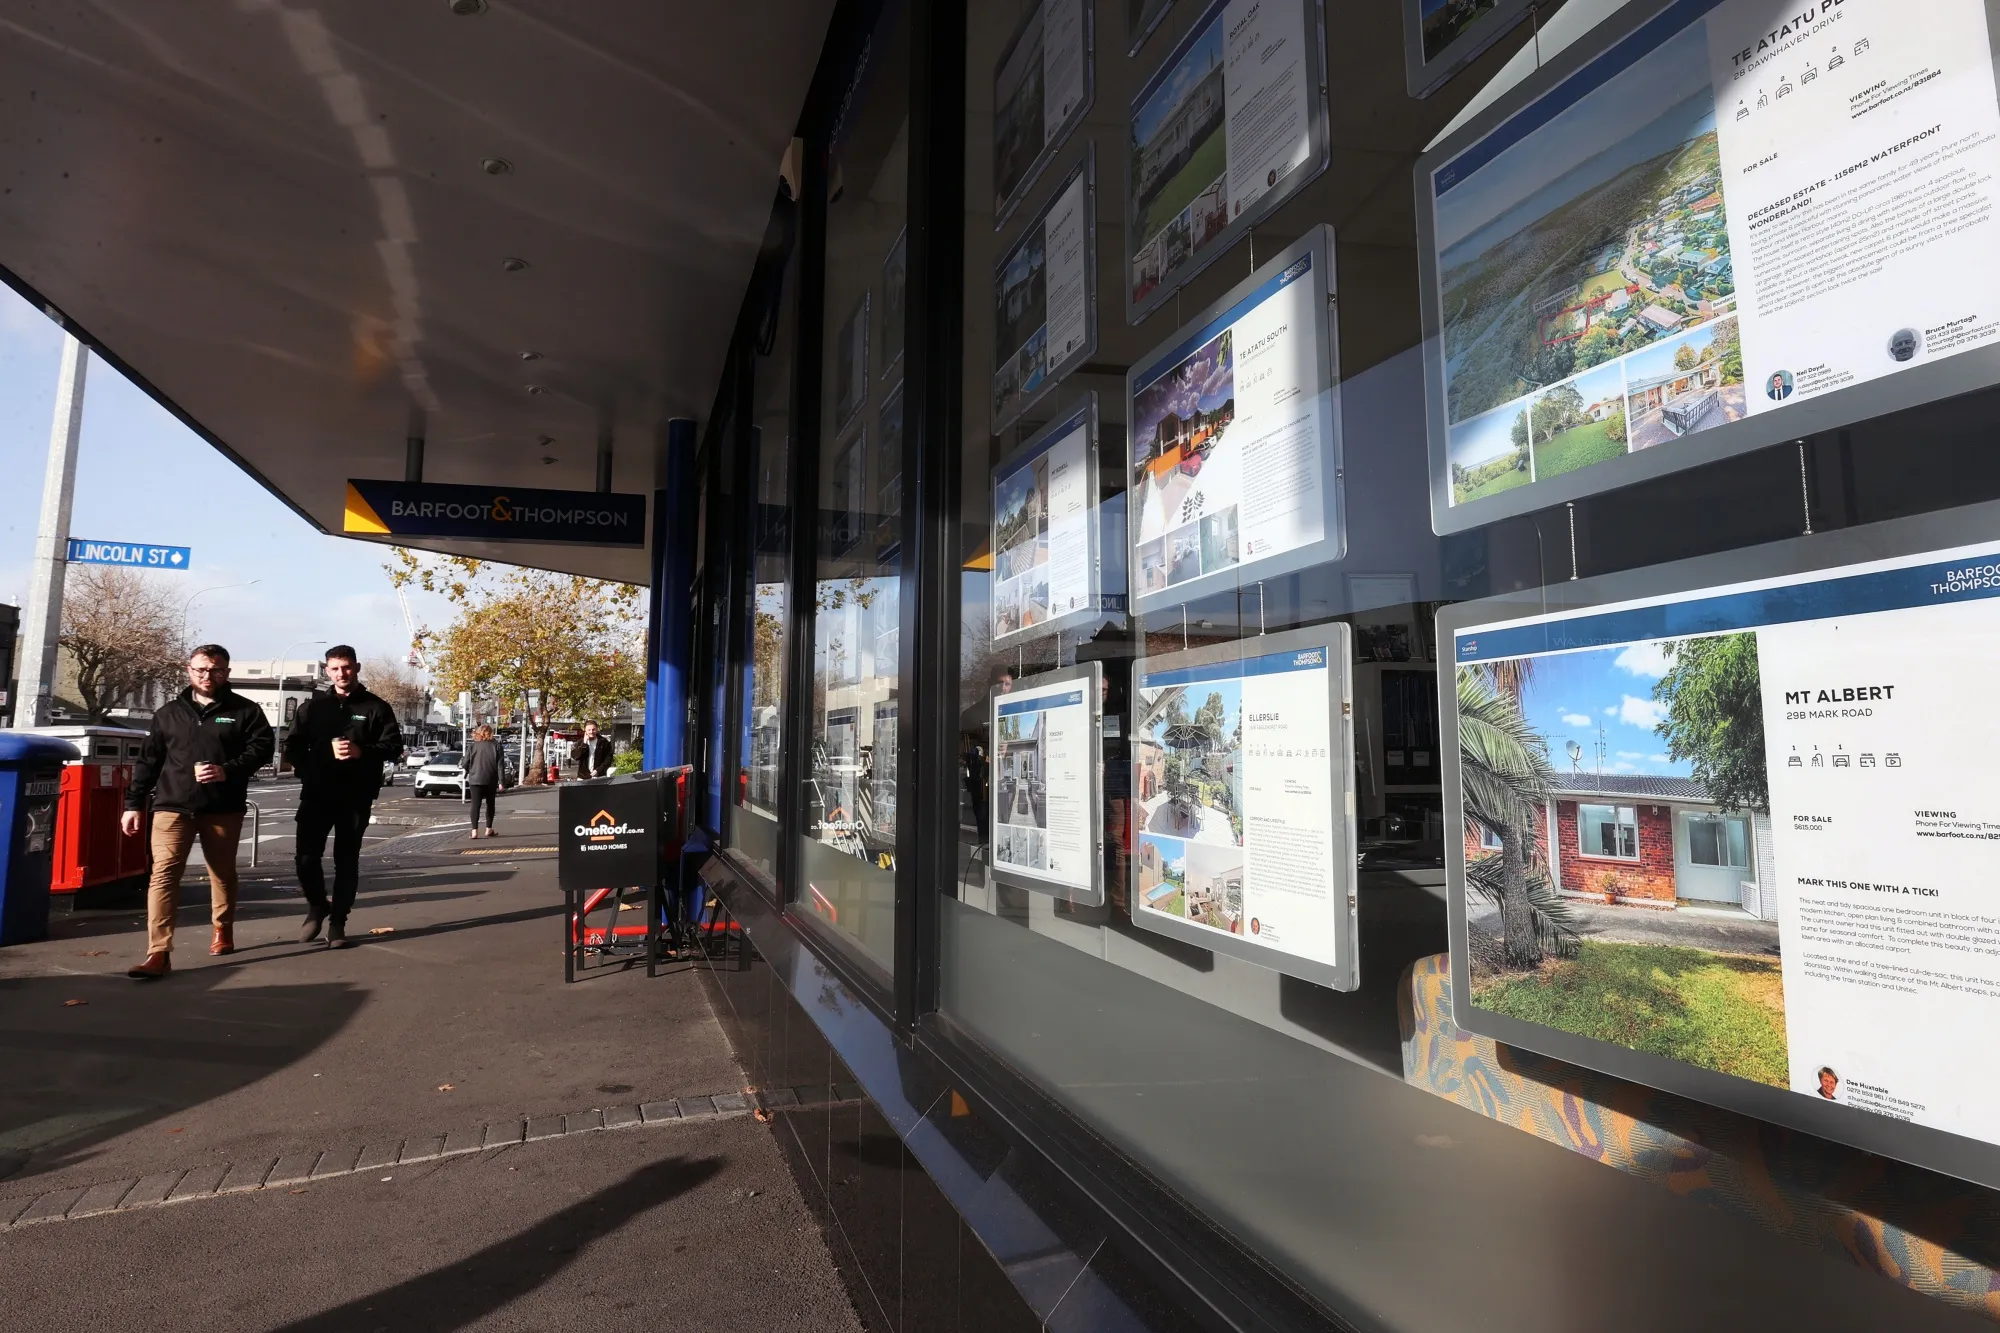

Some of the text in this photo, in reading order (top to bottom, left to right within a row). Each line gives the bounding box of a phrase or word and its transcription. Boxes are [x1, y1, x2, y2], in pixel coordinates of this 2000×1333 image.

[1732, 48, 1752, 67] TE
[1757, 8, 1816, 54] ATATU
[1733, 10, 1843, 82] 28 DAWNHAVEN DRIVE
[1849, 79, 1887, 103] VIEWING
[1850, 67, 1929, 112] Phone For Viewing Times
[1743, 152, 1778, 175] FOR SALE
[1747, 196, 1791, 221] DECEASED
[1792, 179, 1827, 200] ESTATE
[1870, 123, 1942, 163] WATERFRONT
[1748, 197, 1812, 231] WONDERLAND!
[1266, 323, 1288, 343] SOUTH
[1925, 314, 1977, 336] Bruce Murtagh
[392, 496, 628, 527] BARFOOT & THOMPSON
[75, 544, 170, 564] LINCOLN ST
[1785, 685, 1895, 705] MT ALBERT
[1249, 713, 1279, 722] ELLERSLIE
[1786, 707, 1873, 720] 29B MARK ROAD
[1811, 815, 1833, 823] SALE
[1914, 810, 1957, 819] VIEWING
[574, 823, 644, 837] OneRoof.co.nz
[1938, 820, 1952, 828] For
[1951, 821, 1982, 831] Viewing
[1797, 877, 1939, 897] MARK THIS ONE WITH A TICK!
[1839, 901, 1852, 909] tidy
[1852, 904, 1881, 912] spacious
[1895, 907, 1928, 917] bedroom
[1950, 913, 1970, 922] block
[1980, 916, 1996, 924] four
[1800, 915, 1812, 923] The
[1812, 918, 1835, 926] current
[1835, 920, 1855, 928] owner
[1855, 922, 1869, 930] had
[1896, 926, 1915, 935] fitted
[1929, 931, 1945, 939] with
[1945, 933, 1971, 942] double
[1971, 936, 1996, 945] glazed
[1879, 915, 1897, 925] living
[1903, 919, 1938, 928] combined
[1938, 922, 1976, 932] bathroom
[1801, 933, 1816, 941] lawn
[1854, 941, 1885, 951] allocated
[1804, 970, 1830, 980] including
[1830, 974, 1841, 982] the
[1841, 976, 1857, 984] train
[1857, 979, 1881, 988] station
[1846, 1079, 1889, 1095] Dee Huxtable
